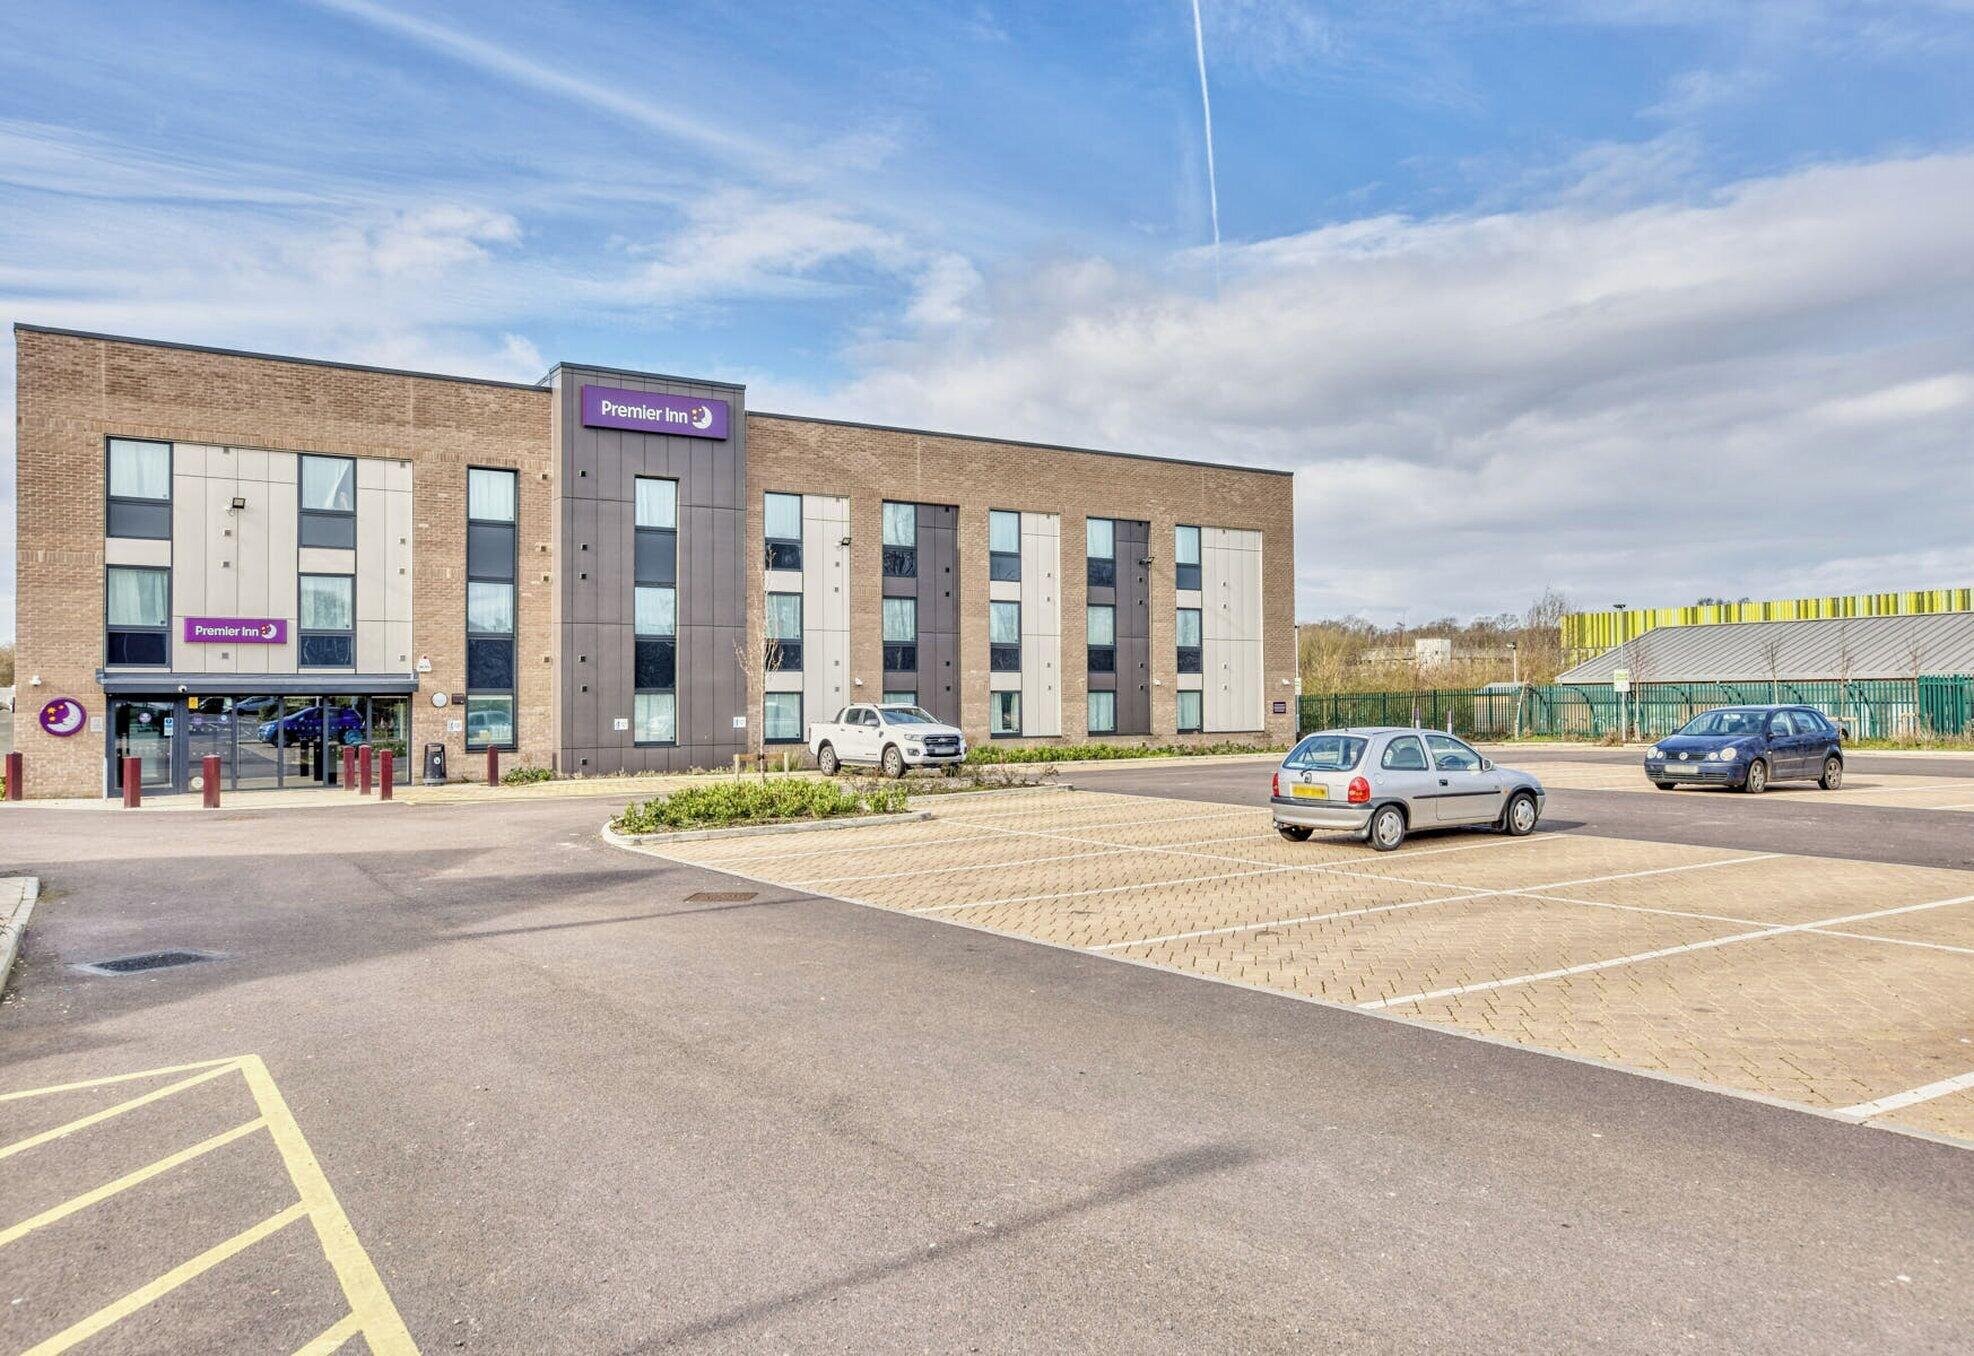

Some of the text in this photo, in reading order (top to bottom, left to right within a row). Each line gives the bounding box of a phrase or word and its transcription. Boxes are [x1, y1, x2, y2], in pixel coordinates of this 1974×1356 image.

[601, 400, 688, 424] Premier Inn
[195, 625, 259, 637] Premier Inn
